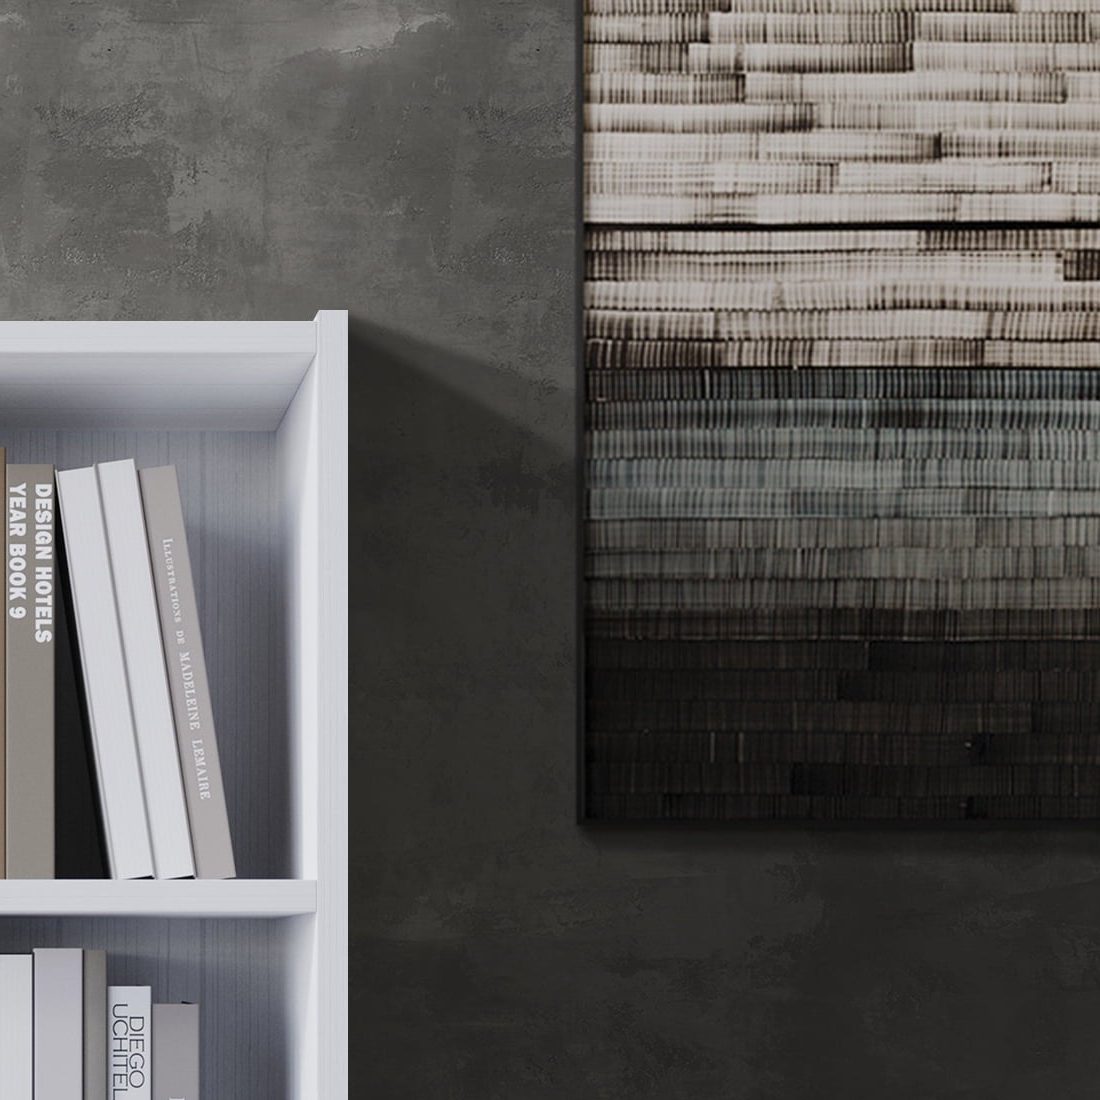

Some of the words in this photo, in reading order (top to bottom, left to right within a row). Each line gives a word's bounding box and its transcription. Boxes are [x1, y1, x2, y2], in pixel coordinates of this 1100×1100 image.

[9, 483, 26, 536] YEAR
[35, 483, 52, 559] DESIGN
[9, 544, 26, 600] BOOK
[35, 567, 52, 643] HOTELS
[9, 607, 26, 619] 9
[178, 652, 200, 730] MADELEINE
[191, 740, 211, 800] LEMAIRE
[113, 1003, 128, 1100] UCHITEL
[129, 1016, 145, 1089] DIEGO
